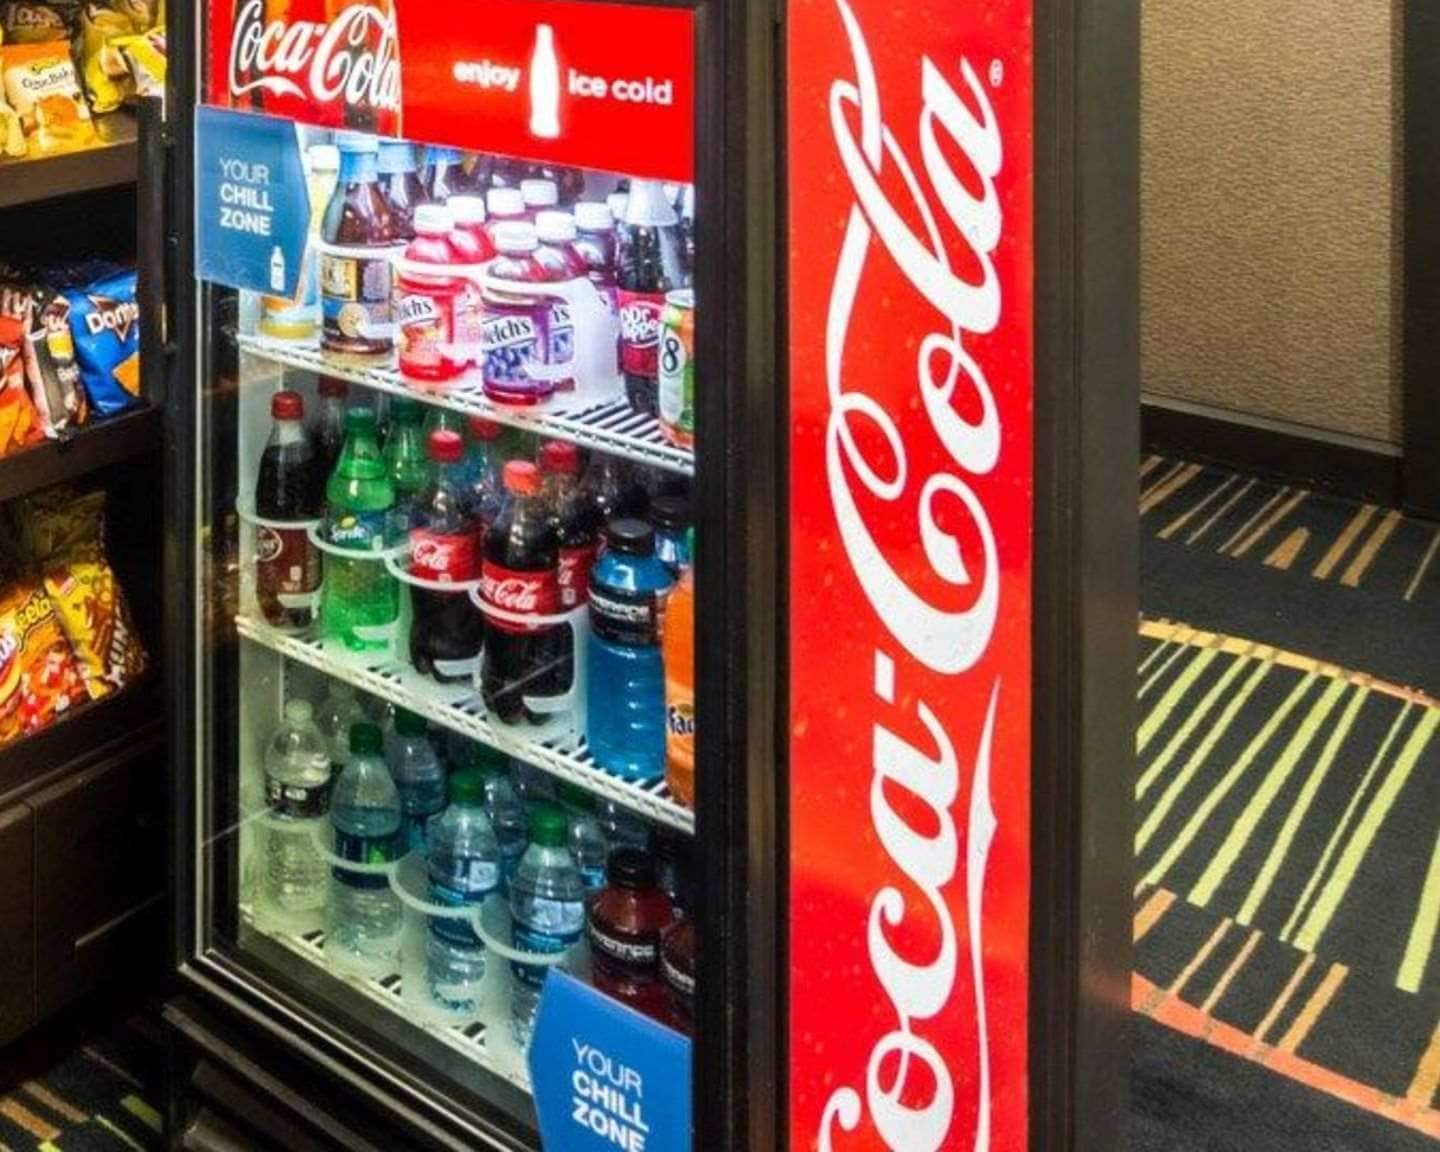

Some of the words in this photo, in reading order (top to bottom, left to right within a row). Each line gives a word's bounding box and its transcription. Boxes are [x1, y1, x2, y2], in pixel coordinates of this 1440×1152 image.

[452, 59, 520, 91] enjoy
[568, 69, 606, 98] ice
[612, 76, 674, 106] cold
[218, 157, 270, 185] YOUR
[220, 183, 274, 212] CHILL
[219, 208, 272, 237] ZONE
[485, 317, 532, 346] elch's
[572, 1037, 643, 1097] YOUR
[571, 1070, 649, 1129] CHILL
[572, 1097, 647, 1152] ZONE
